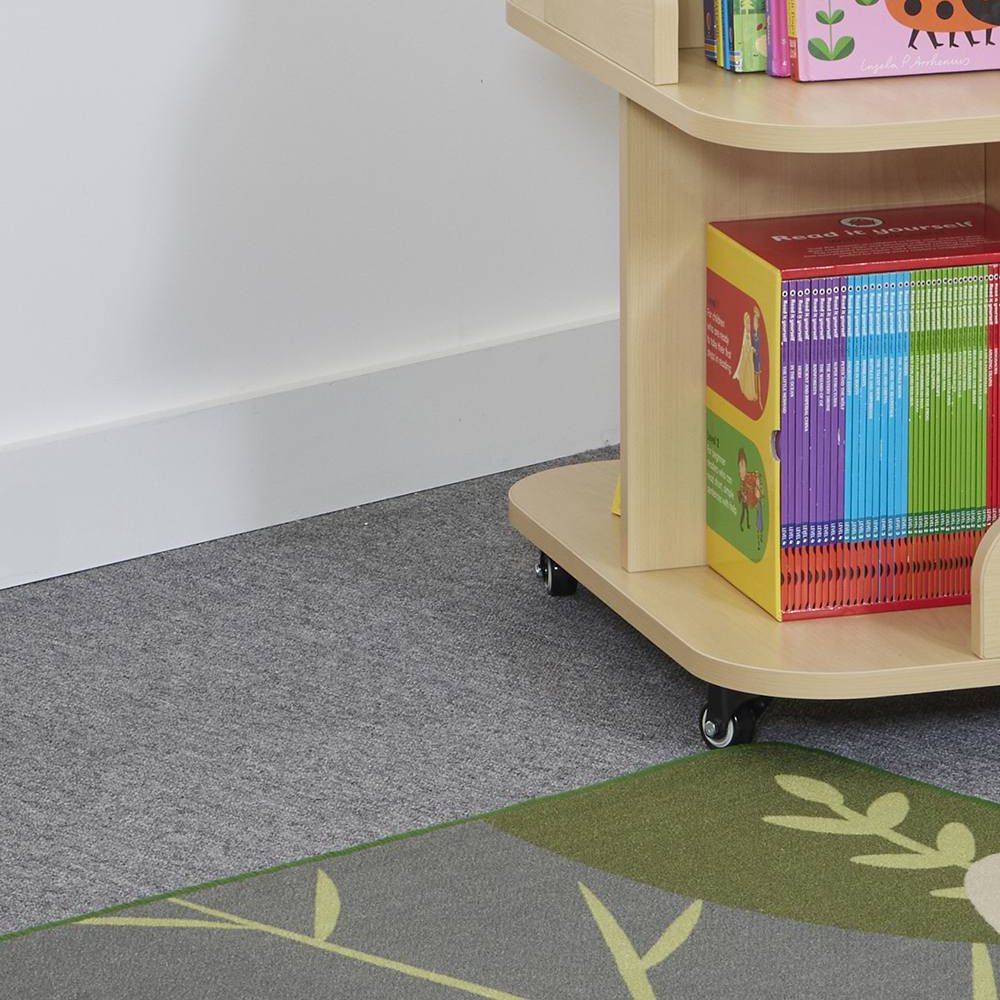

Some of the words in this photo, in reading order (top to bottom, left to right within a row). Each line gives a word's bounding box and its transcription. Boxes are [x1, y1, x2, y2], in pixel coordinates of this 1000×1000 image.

[902, 54, 911, 69] P
[771, 231, 839, 242] Read
[844, 229, 866, 237] it
[872, 221, 974, 236] yourself
